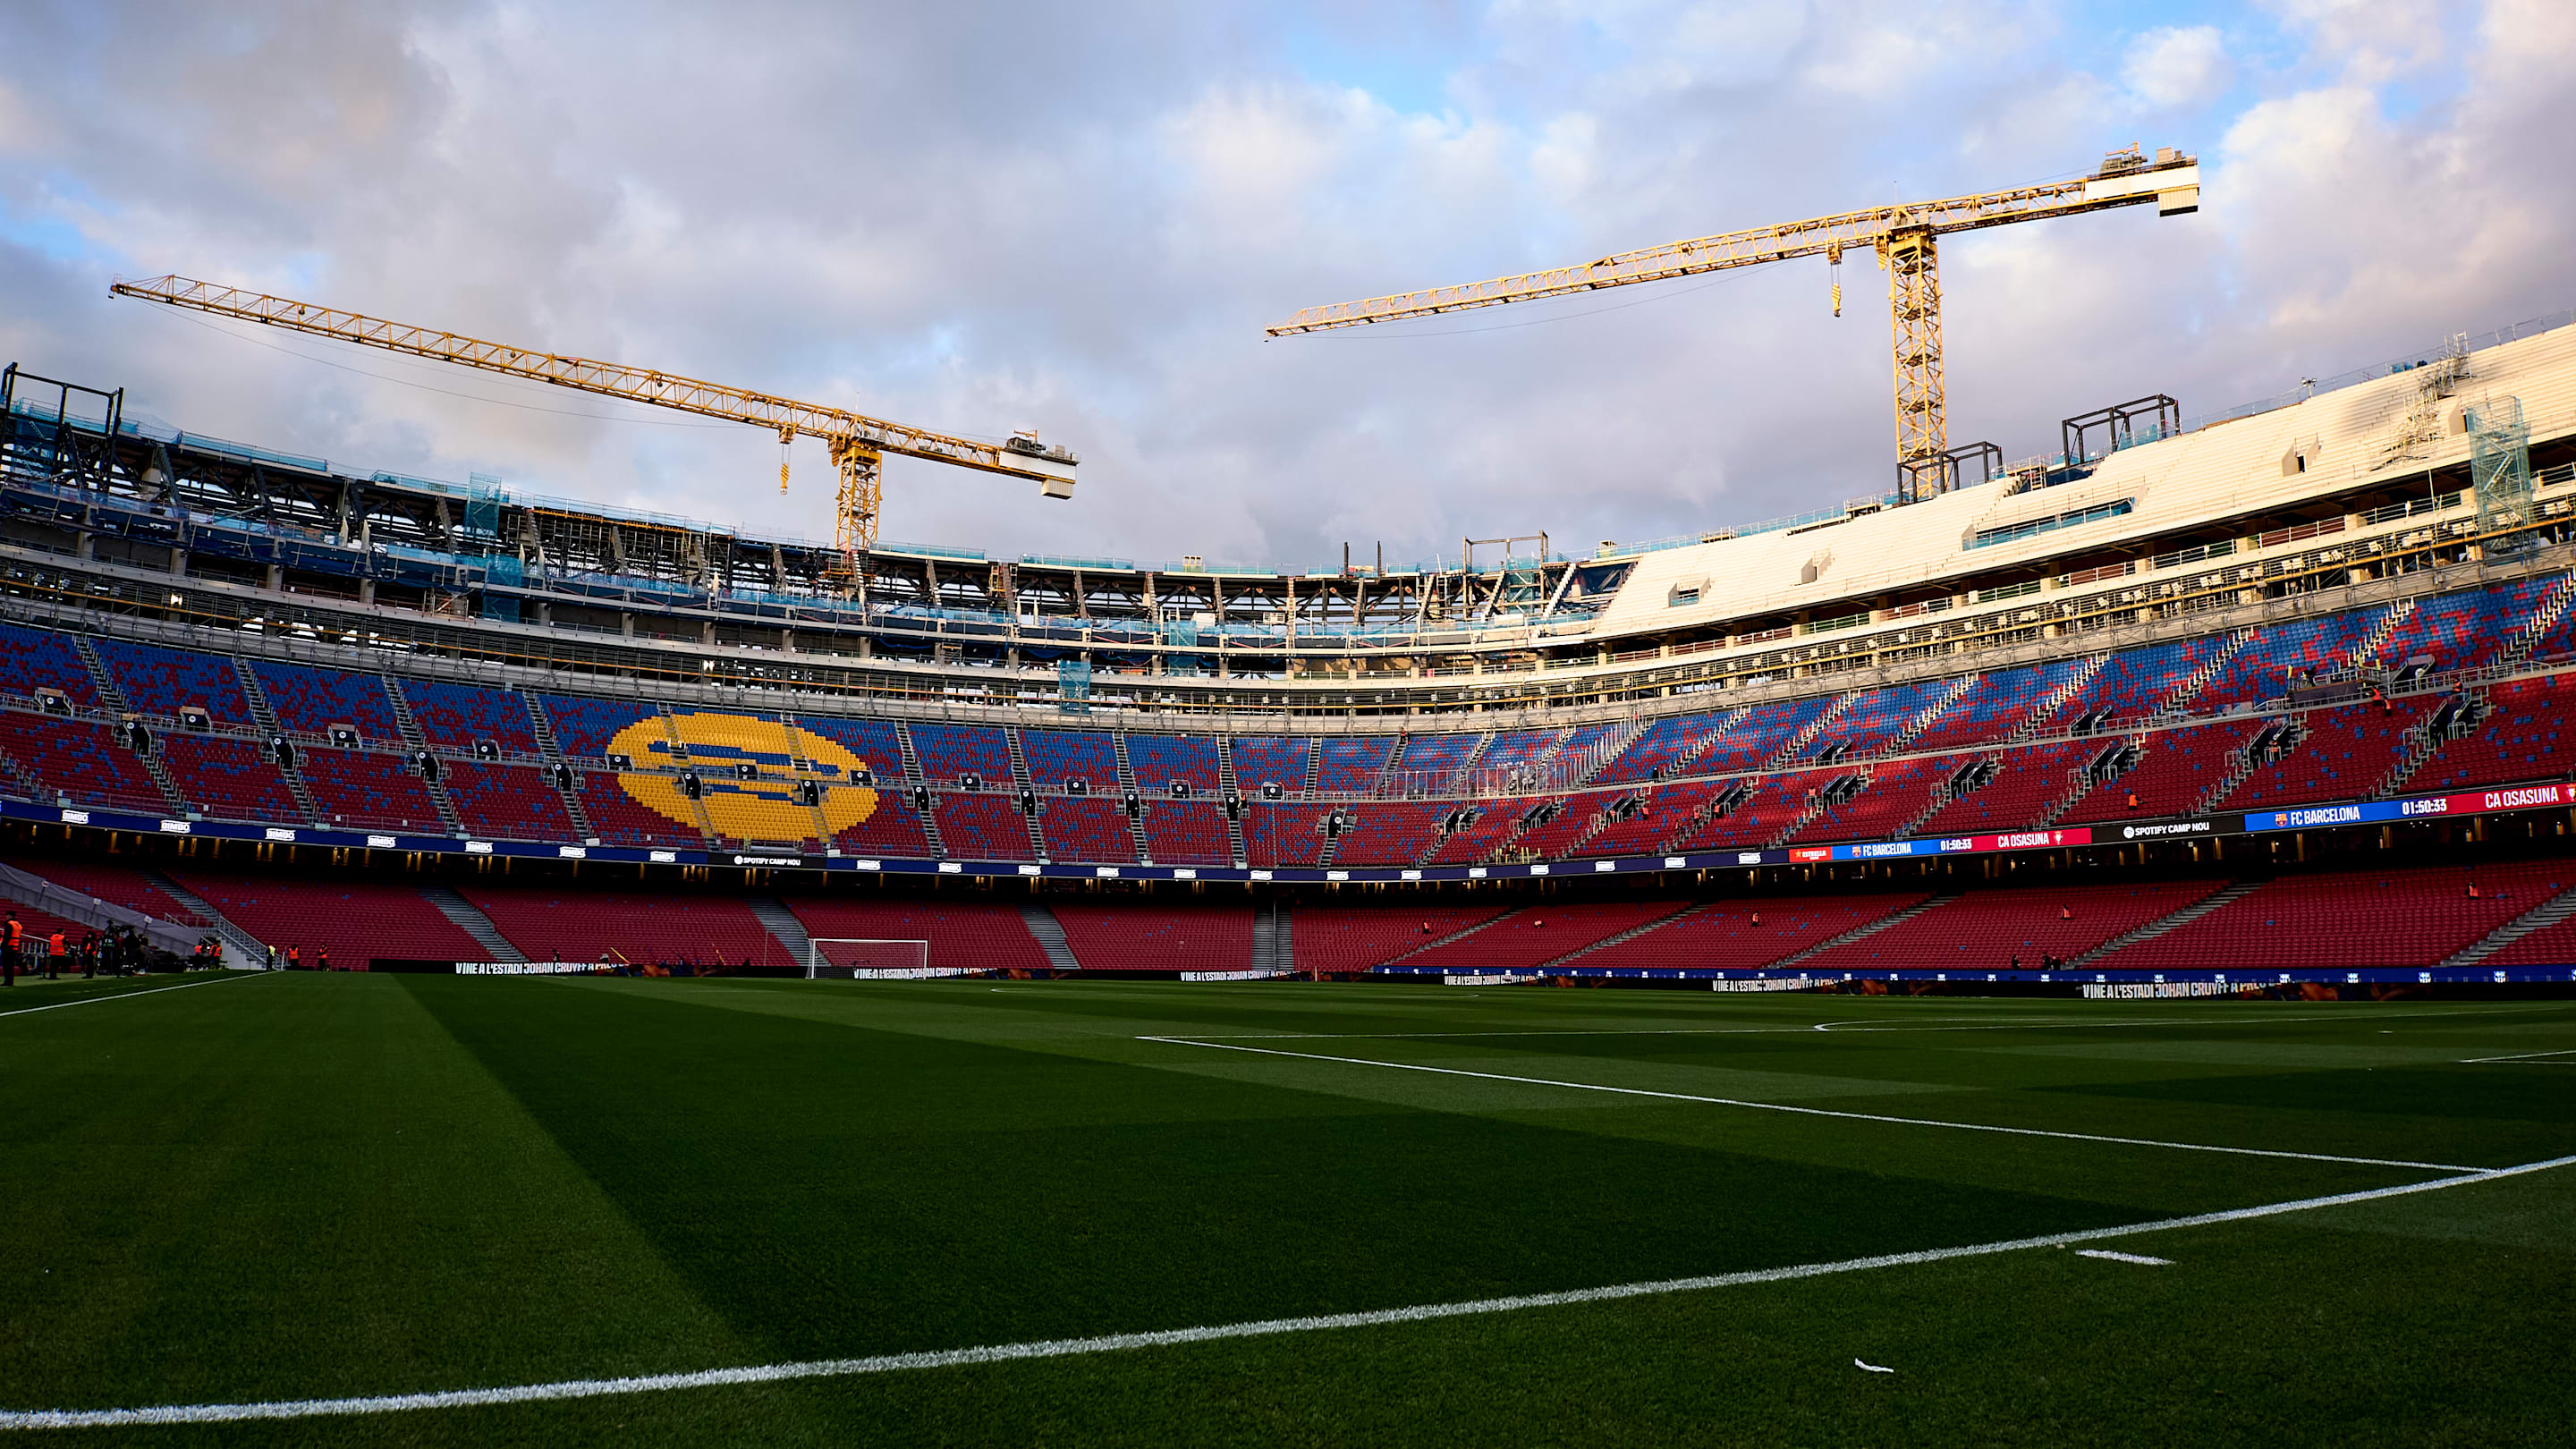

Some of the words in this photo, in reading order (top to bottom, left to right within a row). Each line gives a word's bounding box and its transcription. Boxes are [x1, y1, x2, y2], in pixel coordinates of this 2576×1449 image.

[2291, 811, 2303, 826] FC
[2304, 806, 2360, 825] BARCELONA
[2402, 798, 2447, 815] 01:50:33
[2485, 792, 2501, 809] CA
[2503, 787, 2558, 807] OSASUNA
[63, 811, 89, 823] BIMBO
[161, 821, 191, 832] BIMBO
[2135, 825, 2167, 836] SPOTIFY
[2168, 823, 2190, 834] CAMP
[2192, 822, 2209, 832] NOU
[267, 830, 295, 839] BIMBO
[1863, 845, 1872, 857] FC
[1873, 843, 1911, 856] BARCELONA
[1940, 838, 1972, 851] 01:50:33
[1997, 835, 2009, 848] CA
[2010, 833, 2049, 846] OSASUNA
[743, 857, 768, 865] SPOTIFY
[456, 962, 478, 975] VINE
[479, 963, 486, 975] A
[487, 962, 522, 974] L'ESTADI
[523, 962, 553, 974] JOHAN
[1181, 971, 1196, 981] VINE
[1197, 972, 1201, 981] A
[1201, 971, 1226, 981] L'ESTADI
[1227, 971, 1247, 981] JOHAN
[1713, 980, 1729, 991] VINE
[1730, 980, 1734, 991] A
[1762, 979, 1786, 991] JOHAN
[2083, 984, 2106, 998] VINE
[2106, 985, 2114, 998] A
[2114, 984, 2154, 998] L'ESTADI
[2155, 983, 2190, 997] JOHAN
[2190, 982, 2229, 996] CRUYFF
